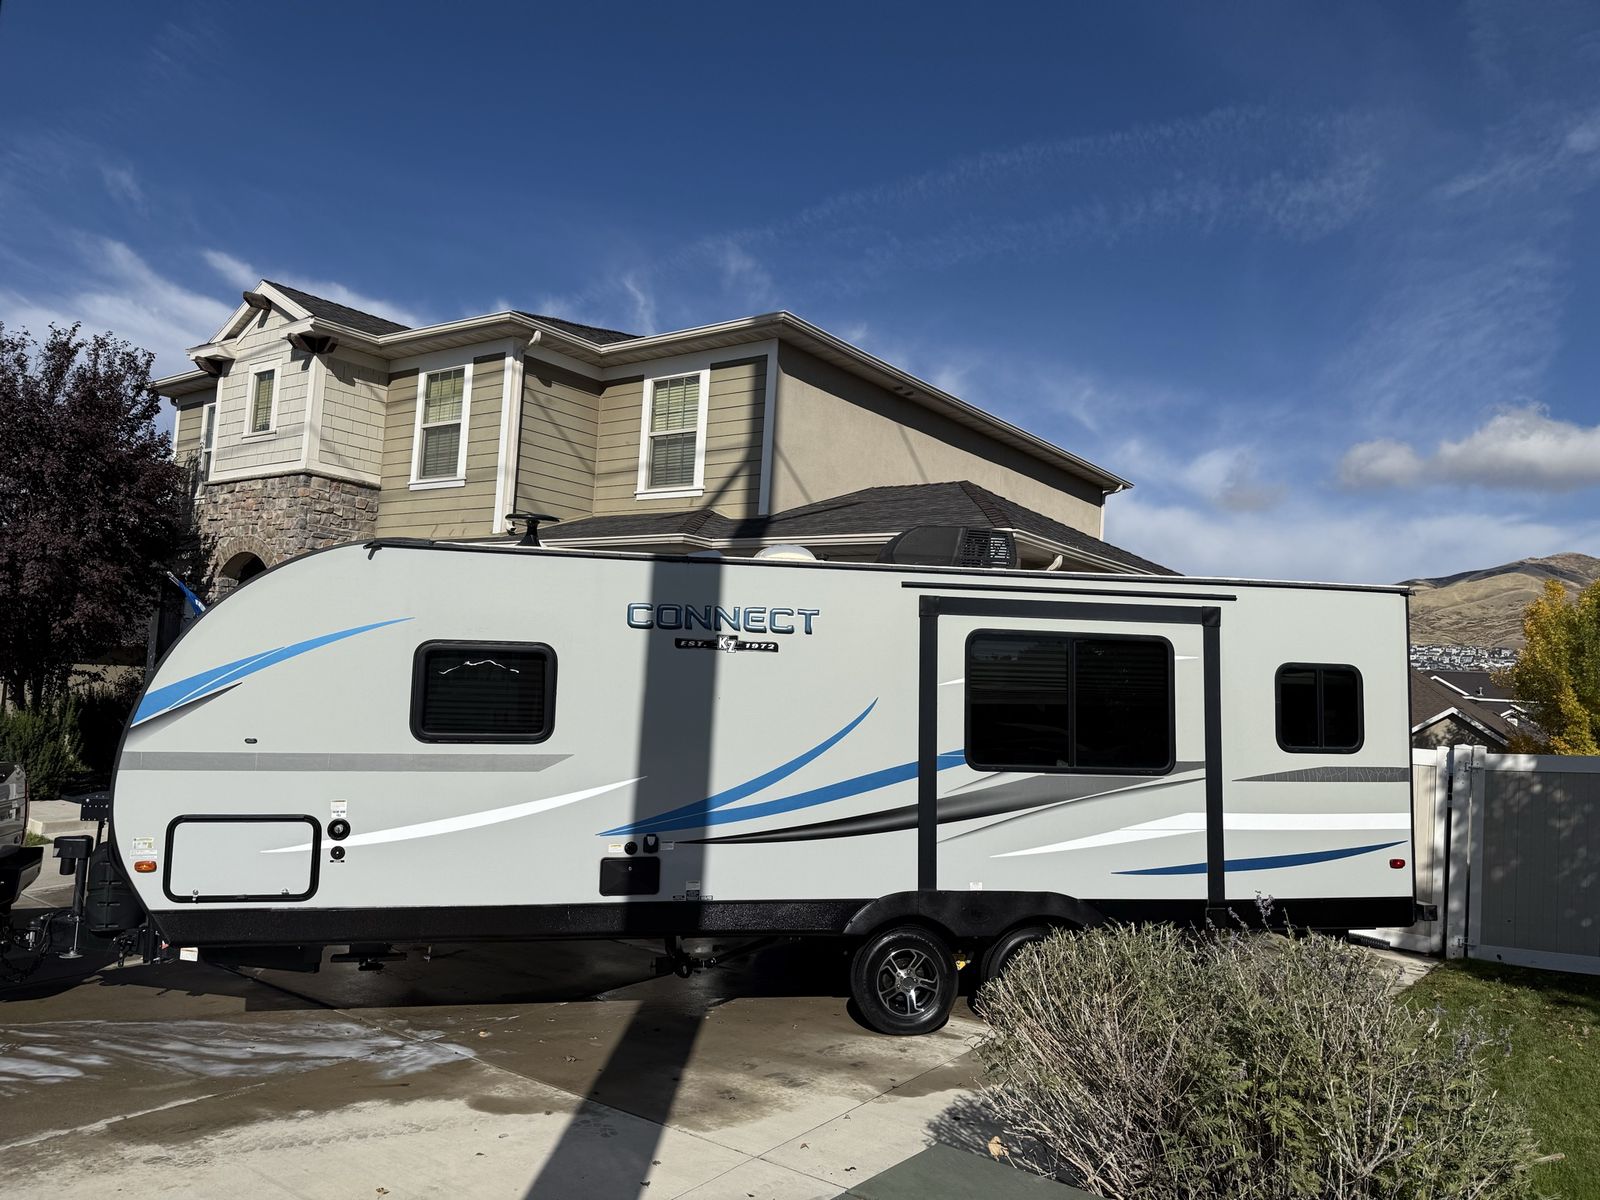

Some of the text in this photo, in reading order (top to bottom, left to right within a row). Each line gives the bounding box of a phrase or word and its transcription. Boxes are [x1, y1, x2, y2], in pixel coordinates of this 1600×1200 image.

[627, 602, 820, 635] CONNECT
[679, 636, 776, 653] EST. KZ 1972
